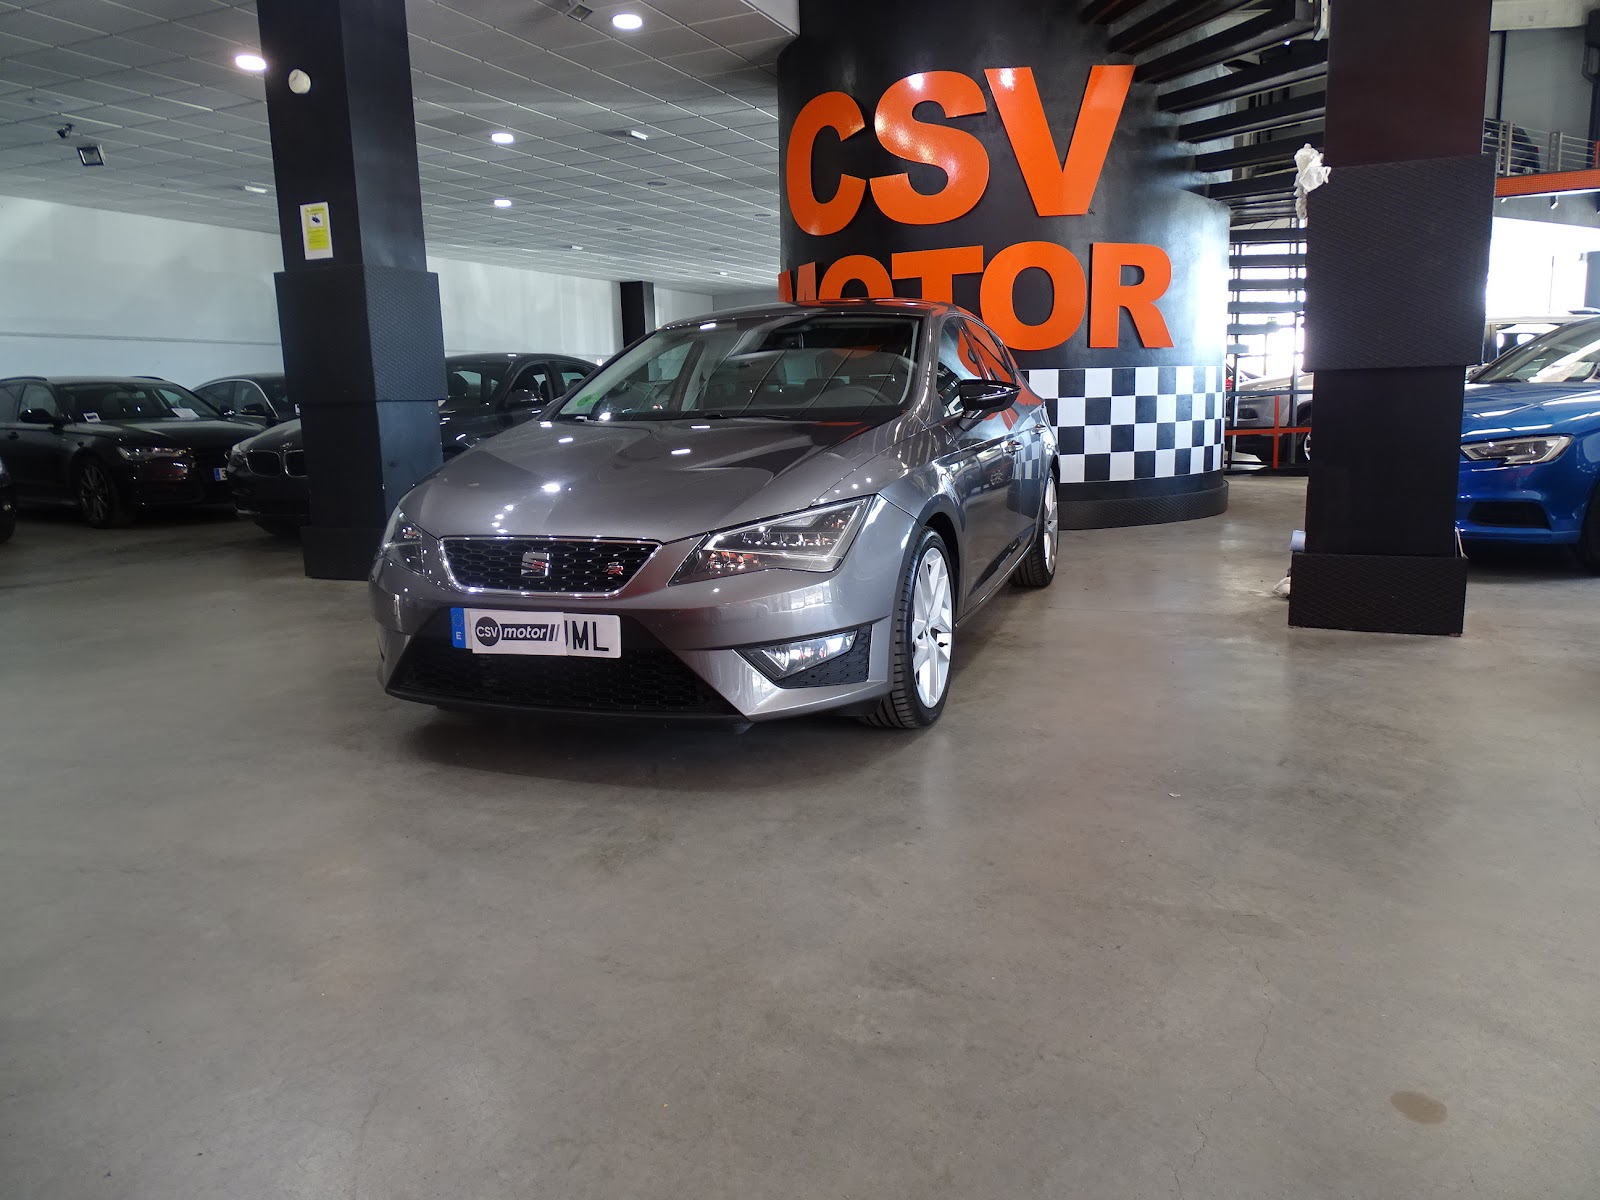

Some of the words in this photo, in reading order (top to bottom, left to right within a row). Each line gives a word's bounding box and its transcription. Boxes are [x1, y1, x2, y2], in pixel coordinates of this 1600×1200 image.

[787, 64, 1135, 235] CSV
[476, 626, 498, 638] CSV
[503, 626, 547, 639] motor
